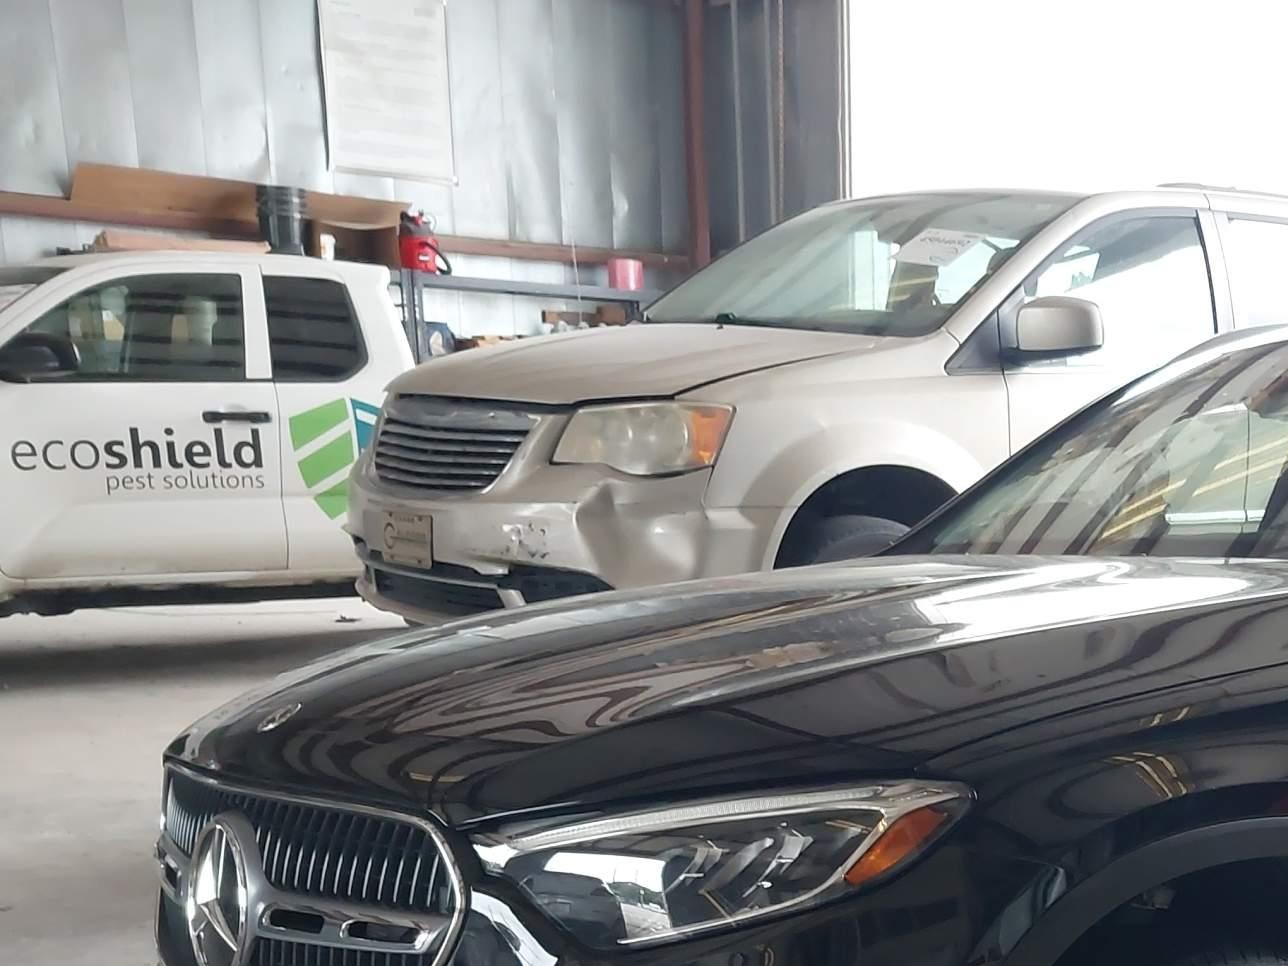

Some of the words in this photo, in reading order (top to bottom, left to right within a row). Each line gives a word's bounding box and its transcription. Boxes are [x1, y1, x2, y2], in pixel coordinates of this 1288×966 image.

[11, 427, 264, 471] ecoshield
[106, 472, 155, 495] pest
[163, 470, 265, 489] solutions
